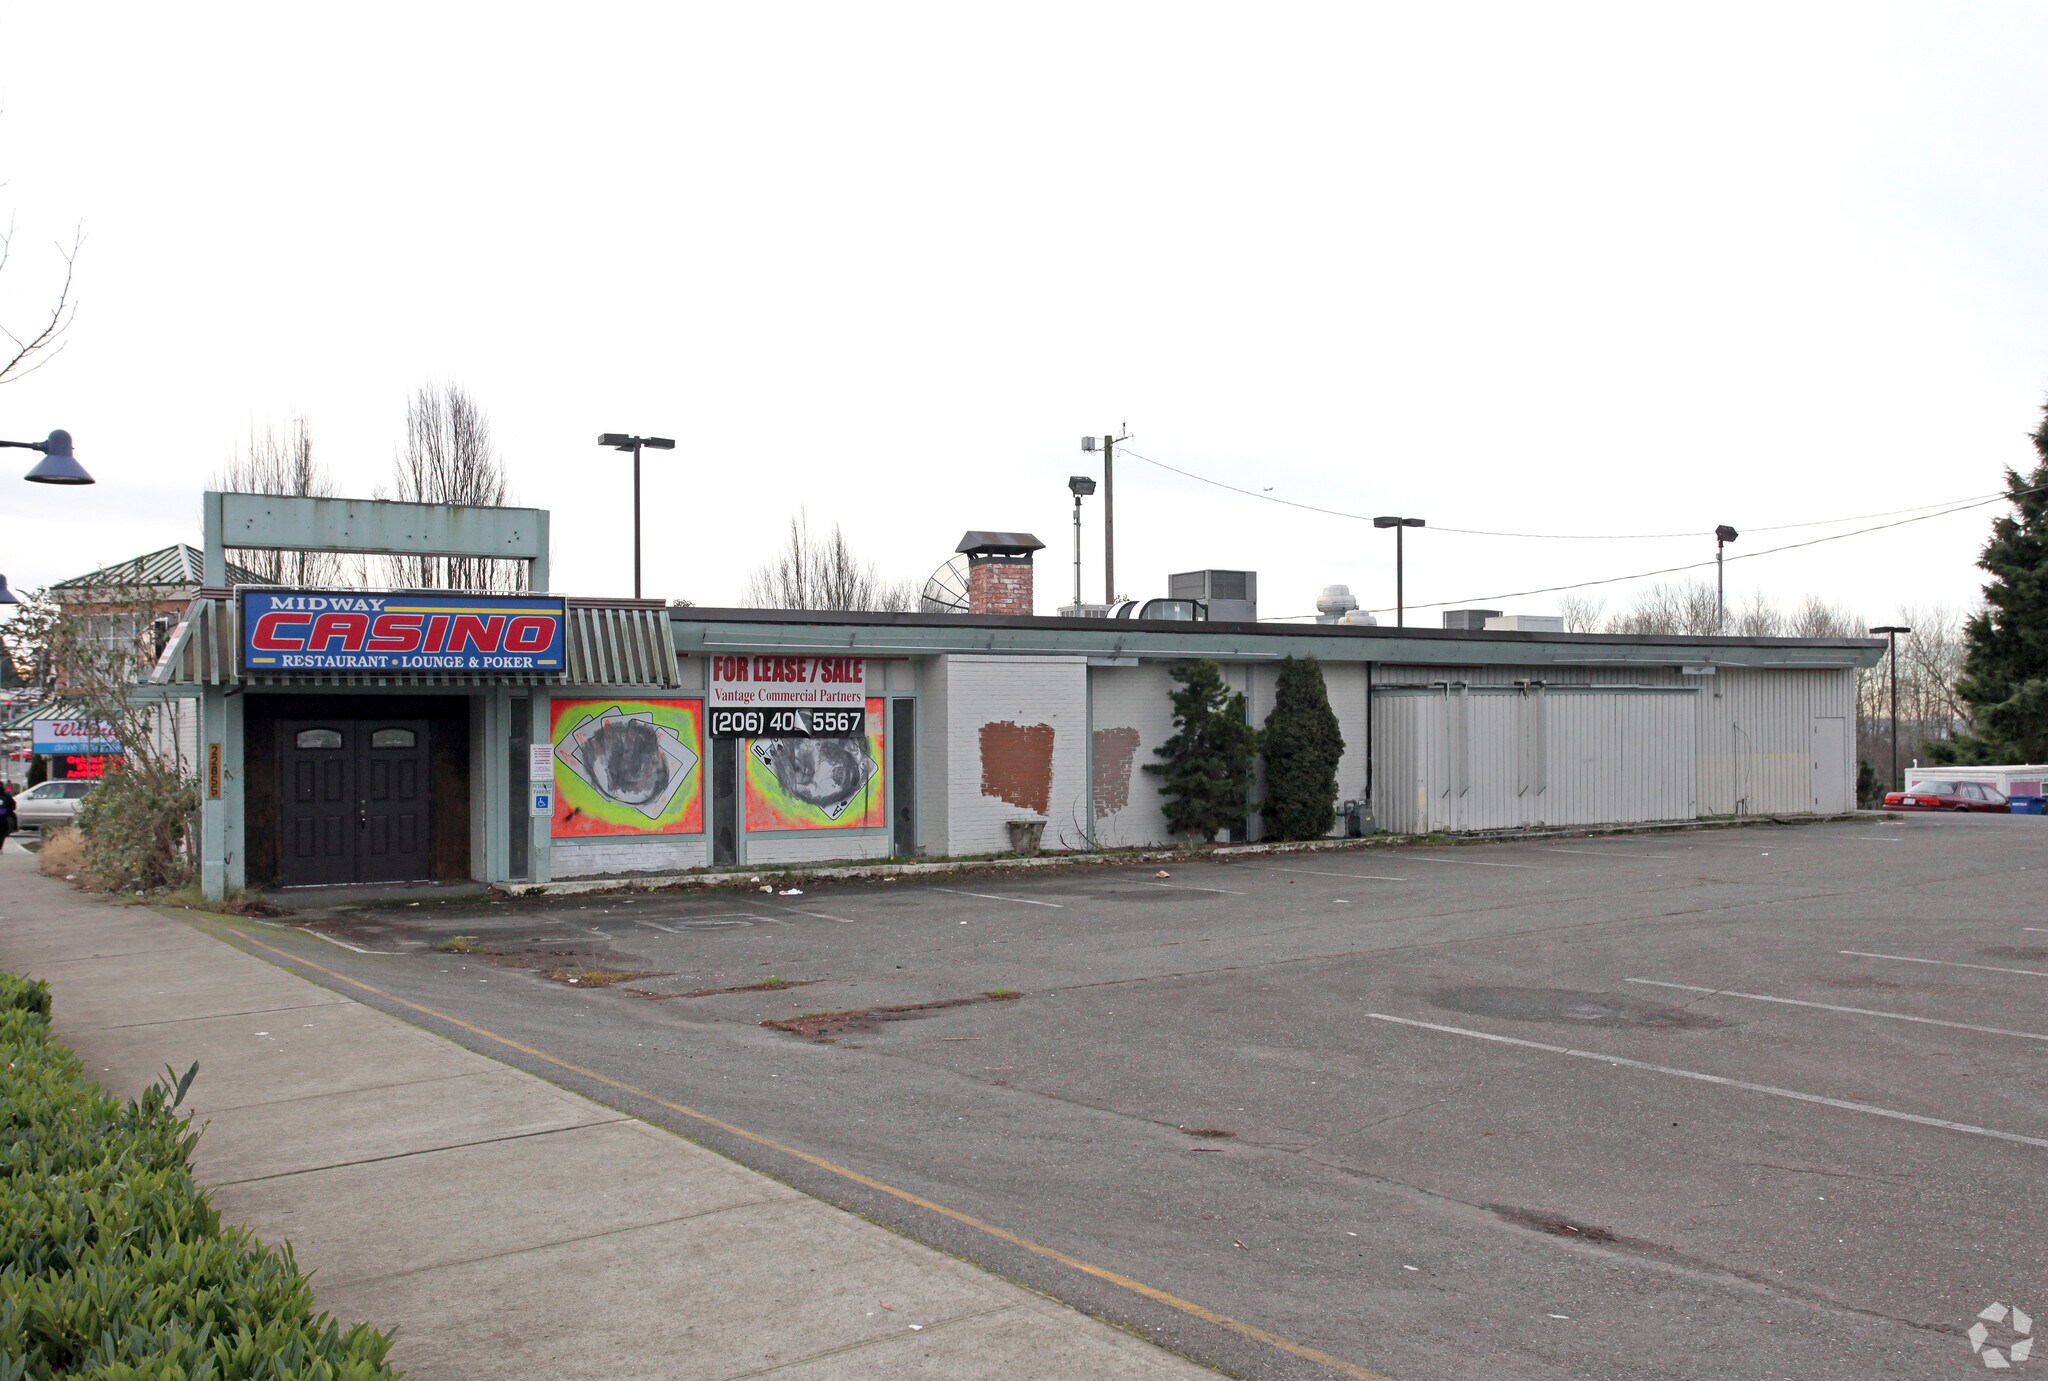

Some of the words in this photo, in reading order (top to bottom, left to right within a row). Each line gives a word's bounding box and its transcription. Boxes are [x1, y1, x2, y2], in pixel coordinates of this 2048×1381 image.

[270, 596, 386, 611] MIDWAY
[251, 611, 557, 653] CASINO
[282, 655, 389, 668] RESTAURANT
[402, 656, 464, 668] LOUNGE
[469, 657, 480, 668] &
[483, 656, 534, 668] POKER
[713, 655, 749, 682] FOR
[715, 688, 755, 704] Vantage
[758, 688, 817, 702] Commercial
[820, 689, 861, 702] Partners
[712, 711, 764, 735] (206)
[813, 712, 861, 732] 5567
